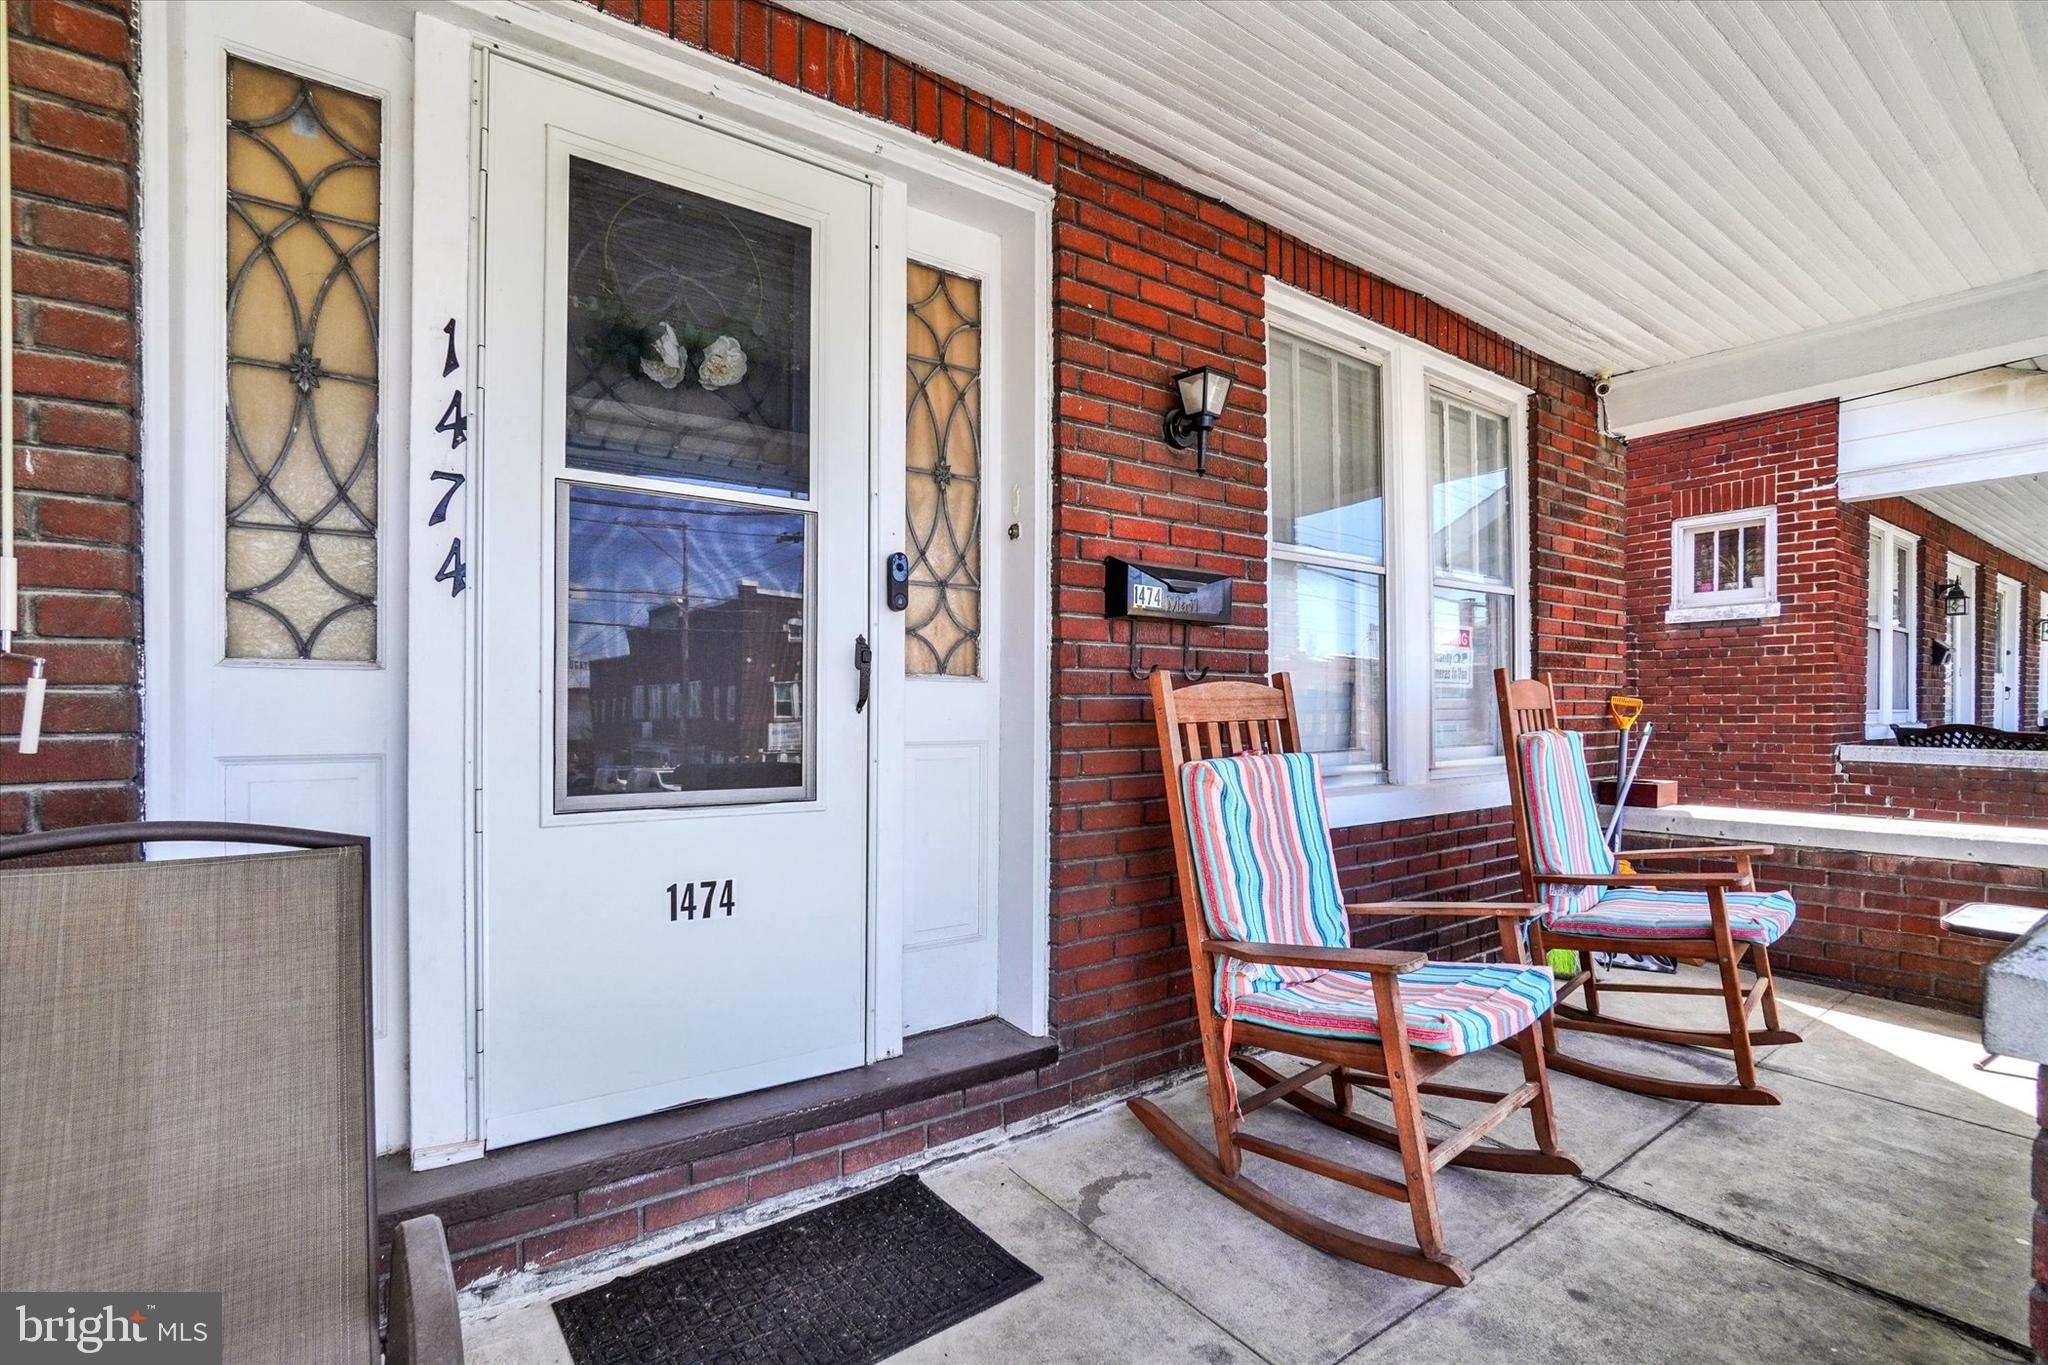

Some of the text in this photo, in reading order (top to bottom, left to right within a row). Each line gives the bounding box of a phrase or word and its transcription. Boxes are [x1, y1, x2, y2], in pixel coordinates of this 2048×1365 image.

[429, 318, 467, 597] 1474
[1134, 586, 1161, 606] 1474
[666, 880, 735, 921] 1474
